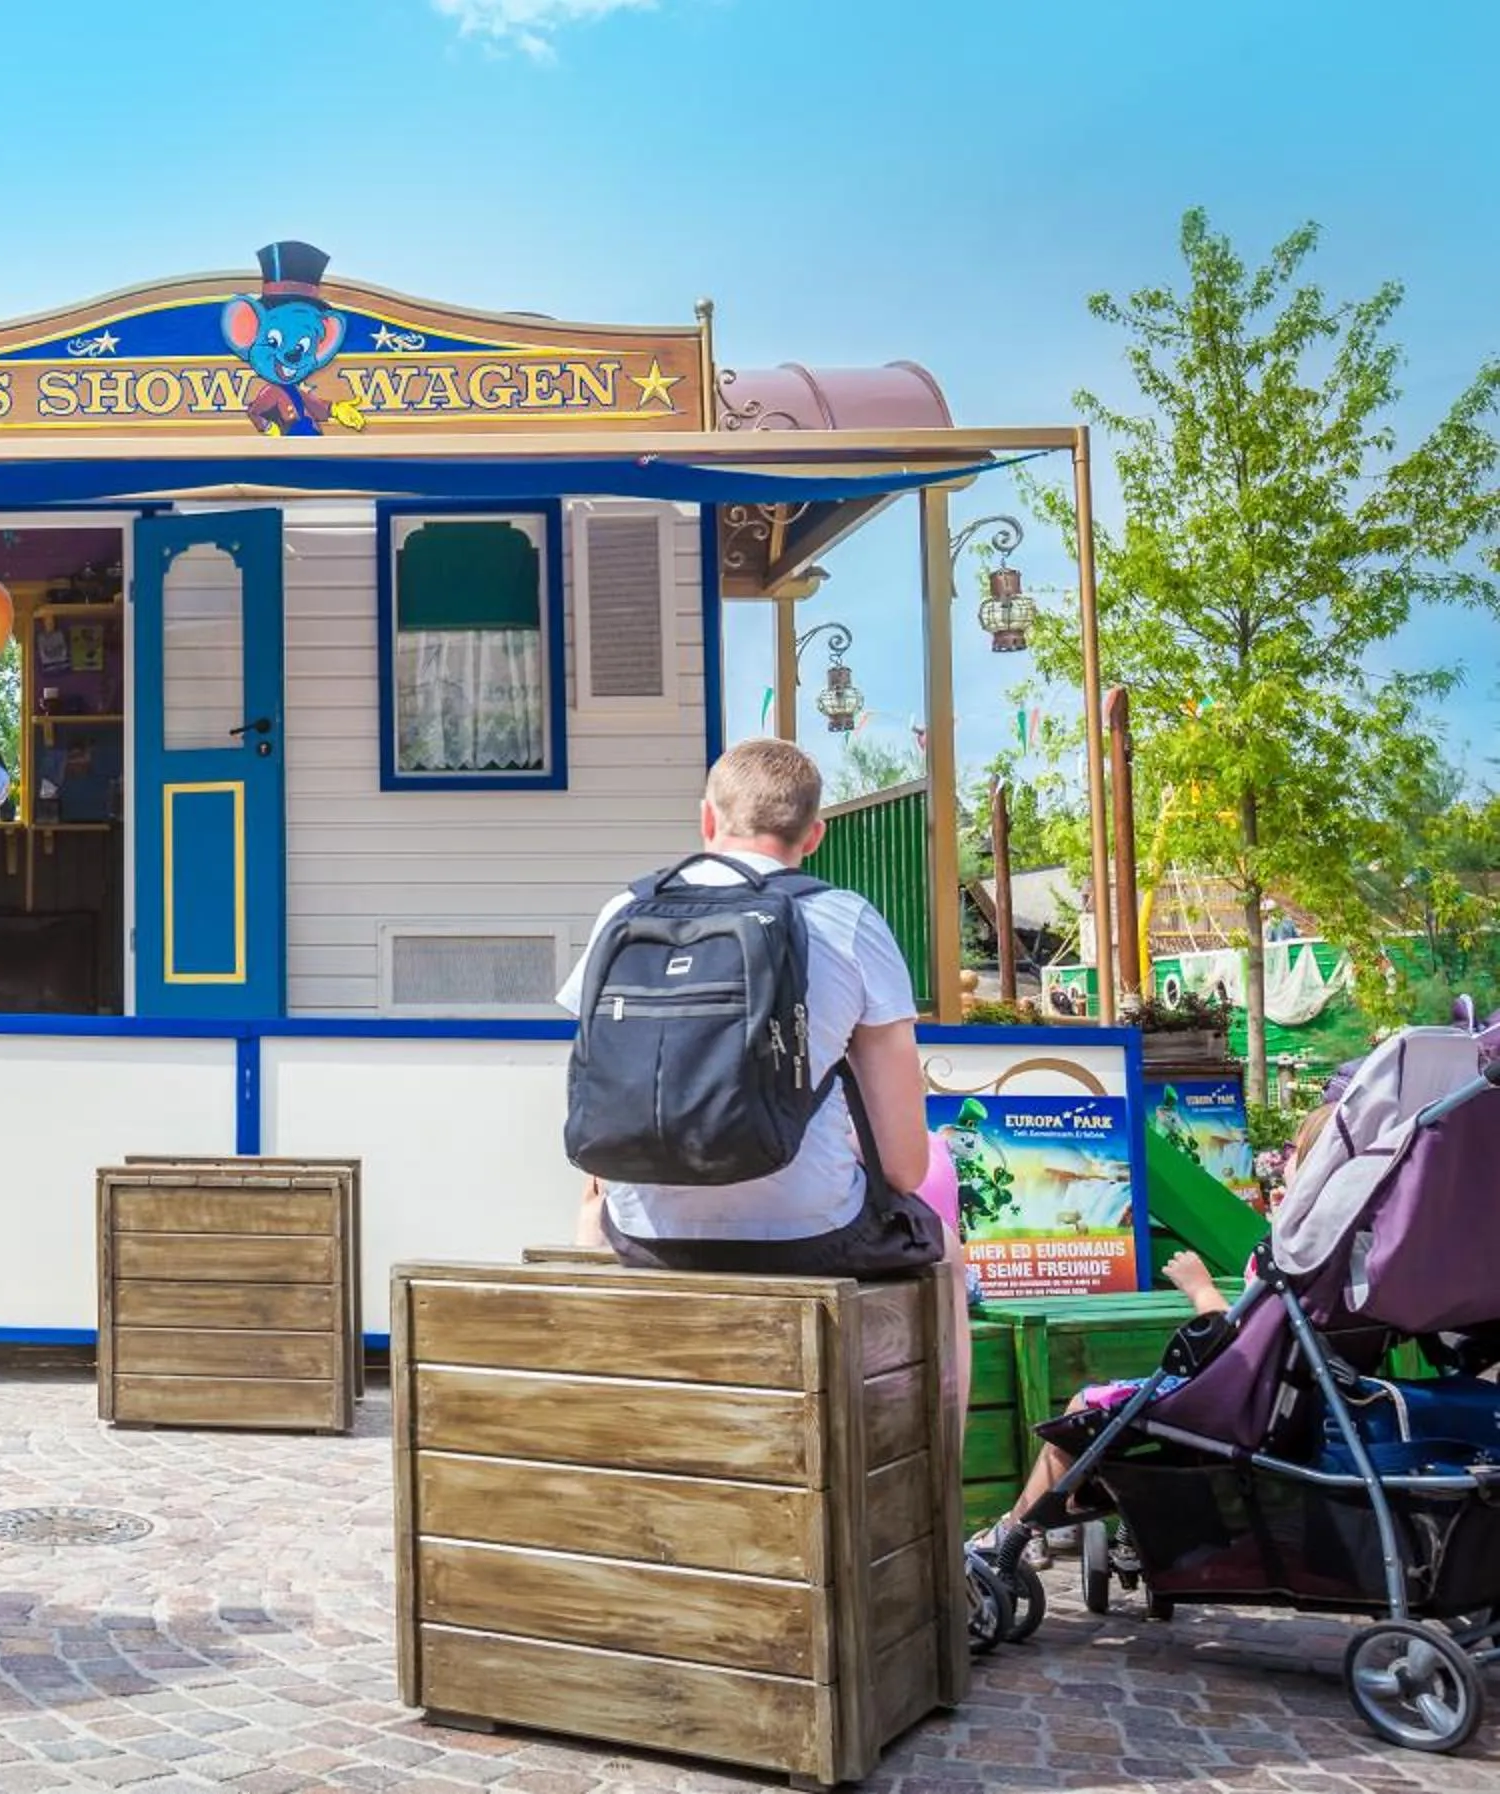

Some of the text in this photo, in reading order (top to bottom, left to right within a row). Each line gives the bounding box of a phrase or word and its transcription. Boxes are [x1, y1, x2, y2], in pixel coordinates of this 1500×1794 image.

[37, 368, 259, 416] SHOW
[338, 362, 623, 412] WAGEN
[1005, 1114, 1113, 1129] EUROPA PARK
[969, 1241, 1126, 1261] HIER ED EUROMAUS
[987, 1263, 1034, 1279] SEINE
[1037, 1260, 1112, 1278] FREUNDE
